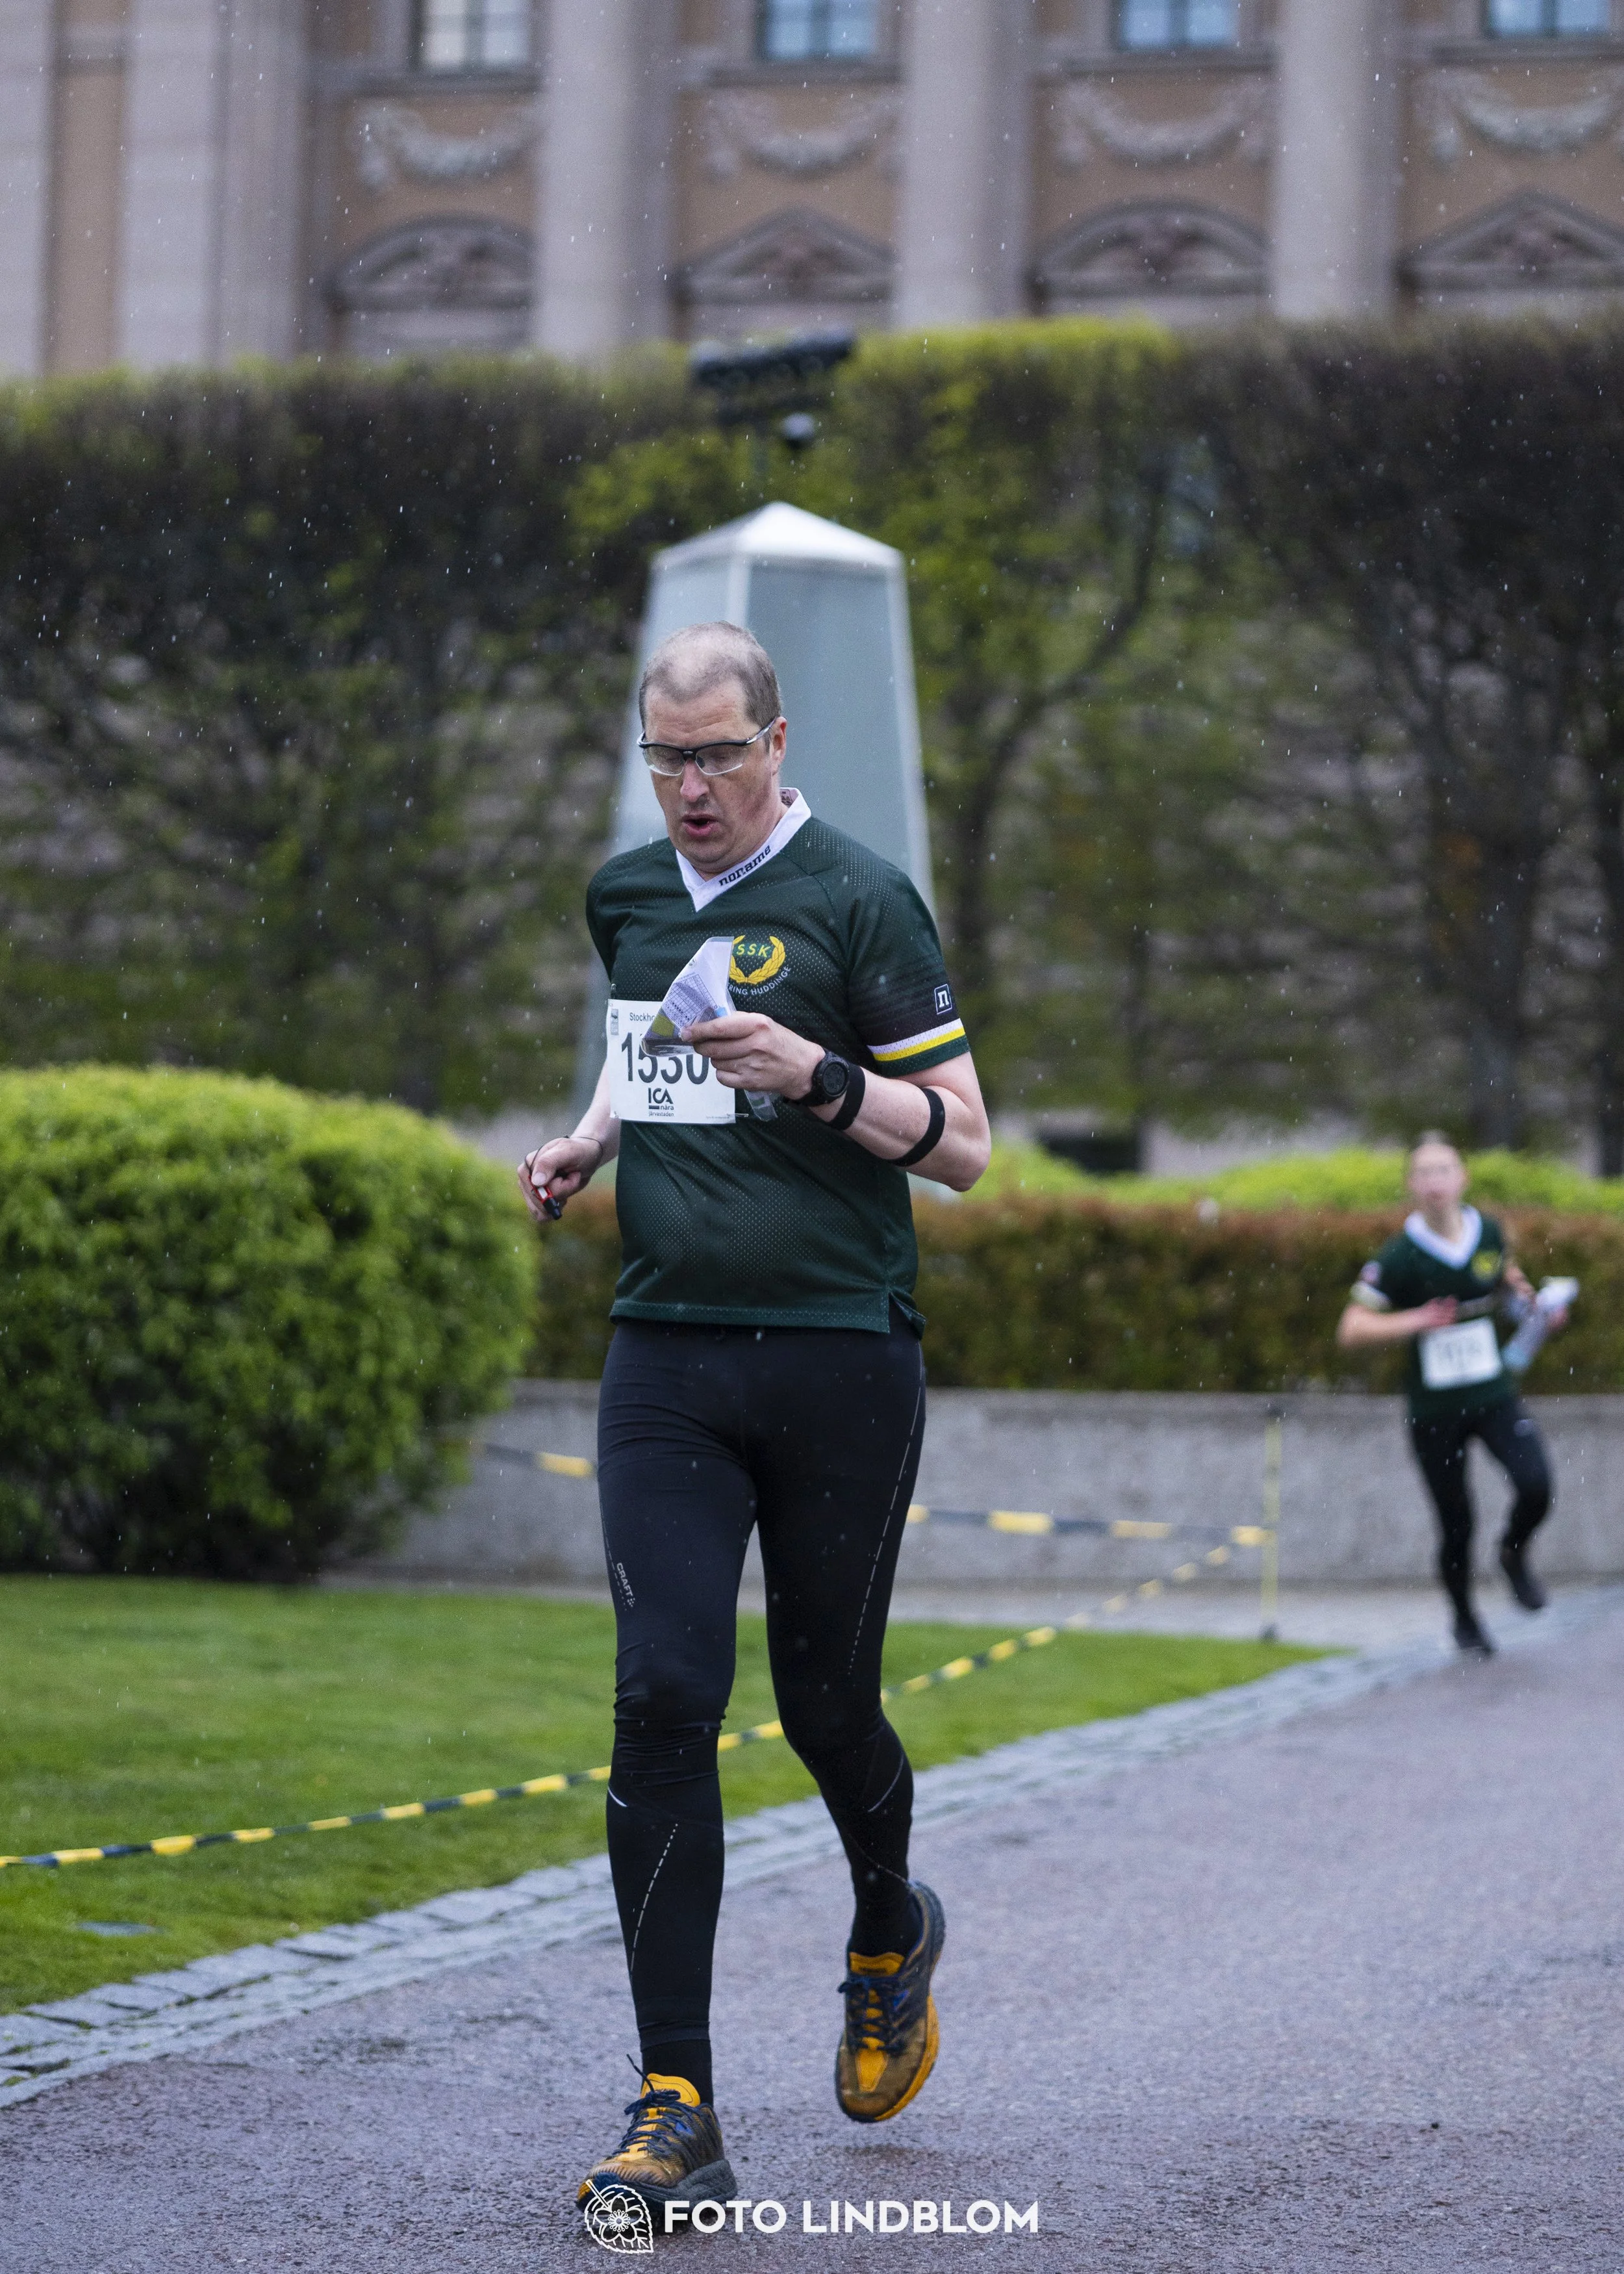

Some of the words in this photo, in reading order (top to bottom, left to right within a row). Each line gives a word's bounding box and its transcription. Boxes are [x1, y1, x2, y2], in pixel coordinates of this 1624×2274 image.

[718, 845, 771, 886] noname
[736, 943, 771, 957] SSK
[728, 982, 748, 995] RING
[750, 966, 791, 995] HUDDINGE
[621, 1032, 709, 1084] 1530
[648, 1087, 674, 1104] ICA
[616, 1563, 633, 1596] CRAFT
